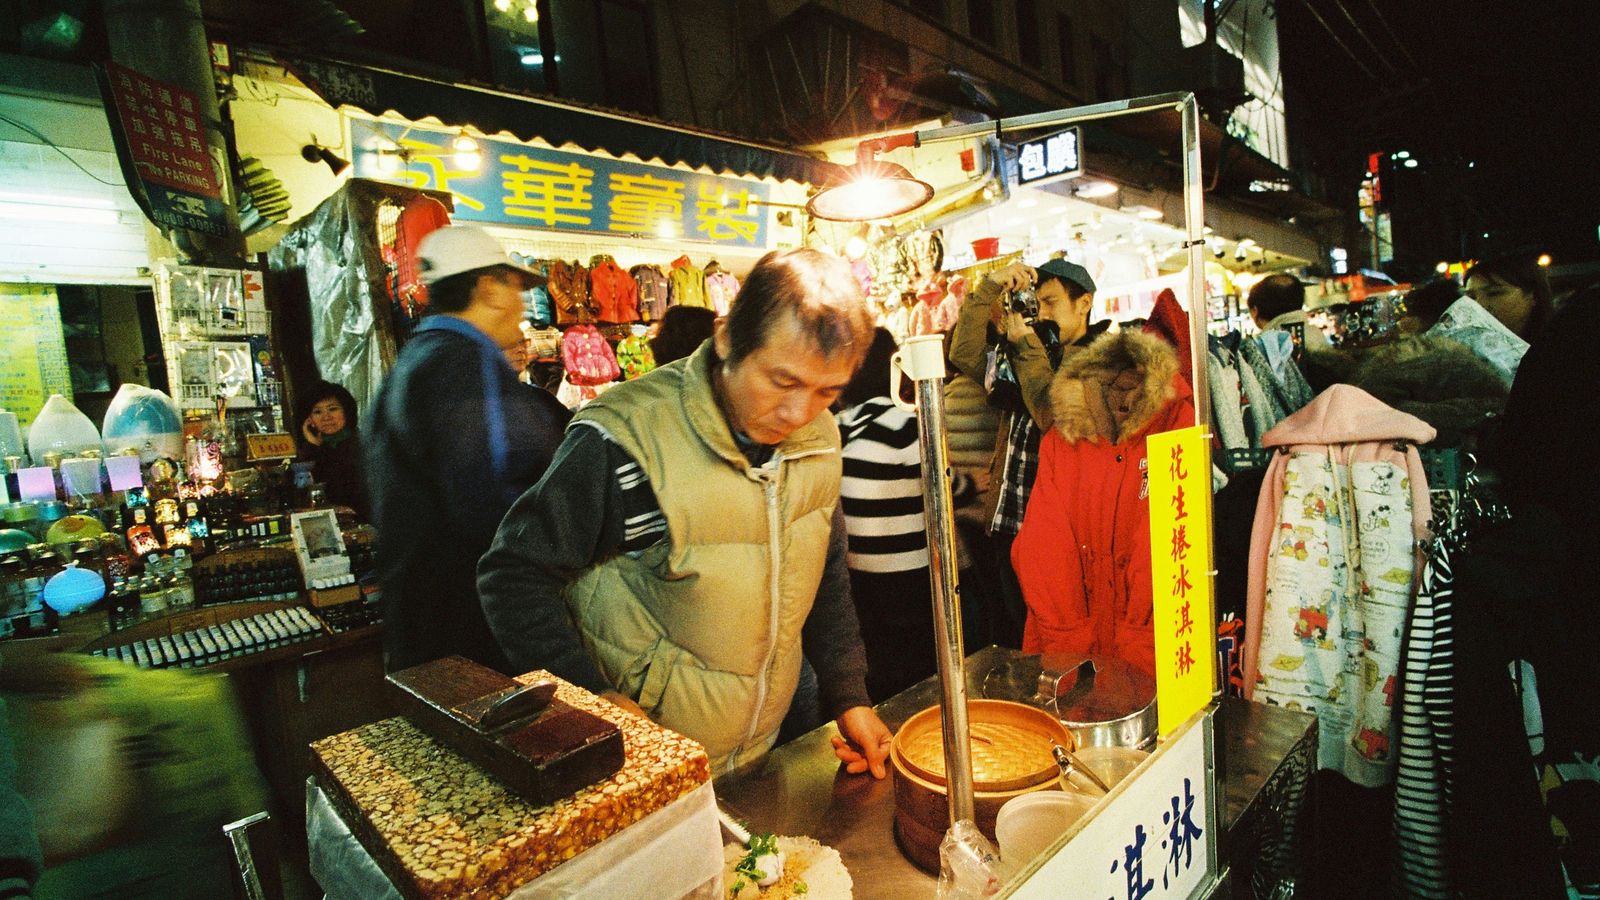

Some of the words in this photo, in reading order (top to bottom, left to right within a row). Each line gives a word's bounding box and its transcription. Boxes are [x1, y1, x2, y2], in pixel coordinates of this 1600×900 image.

[125, 94, 197, 132] 禁止停車
[131, 116, 203, 153] 加強拖吊
[142, 142, 169, 161] Fire
[172, 152, 202, 171] Lane
[164, 166, 211, 190] PARKING
[1108, 778, 1203, 900] 淇淋
